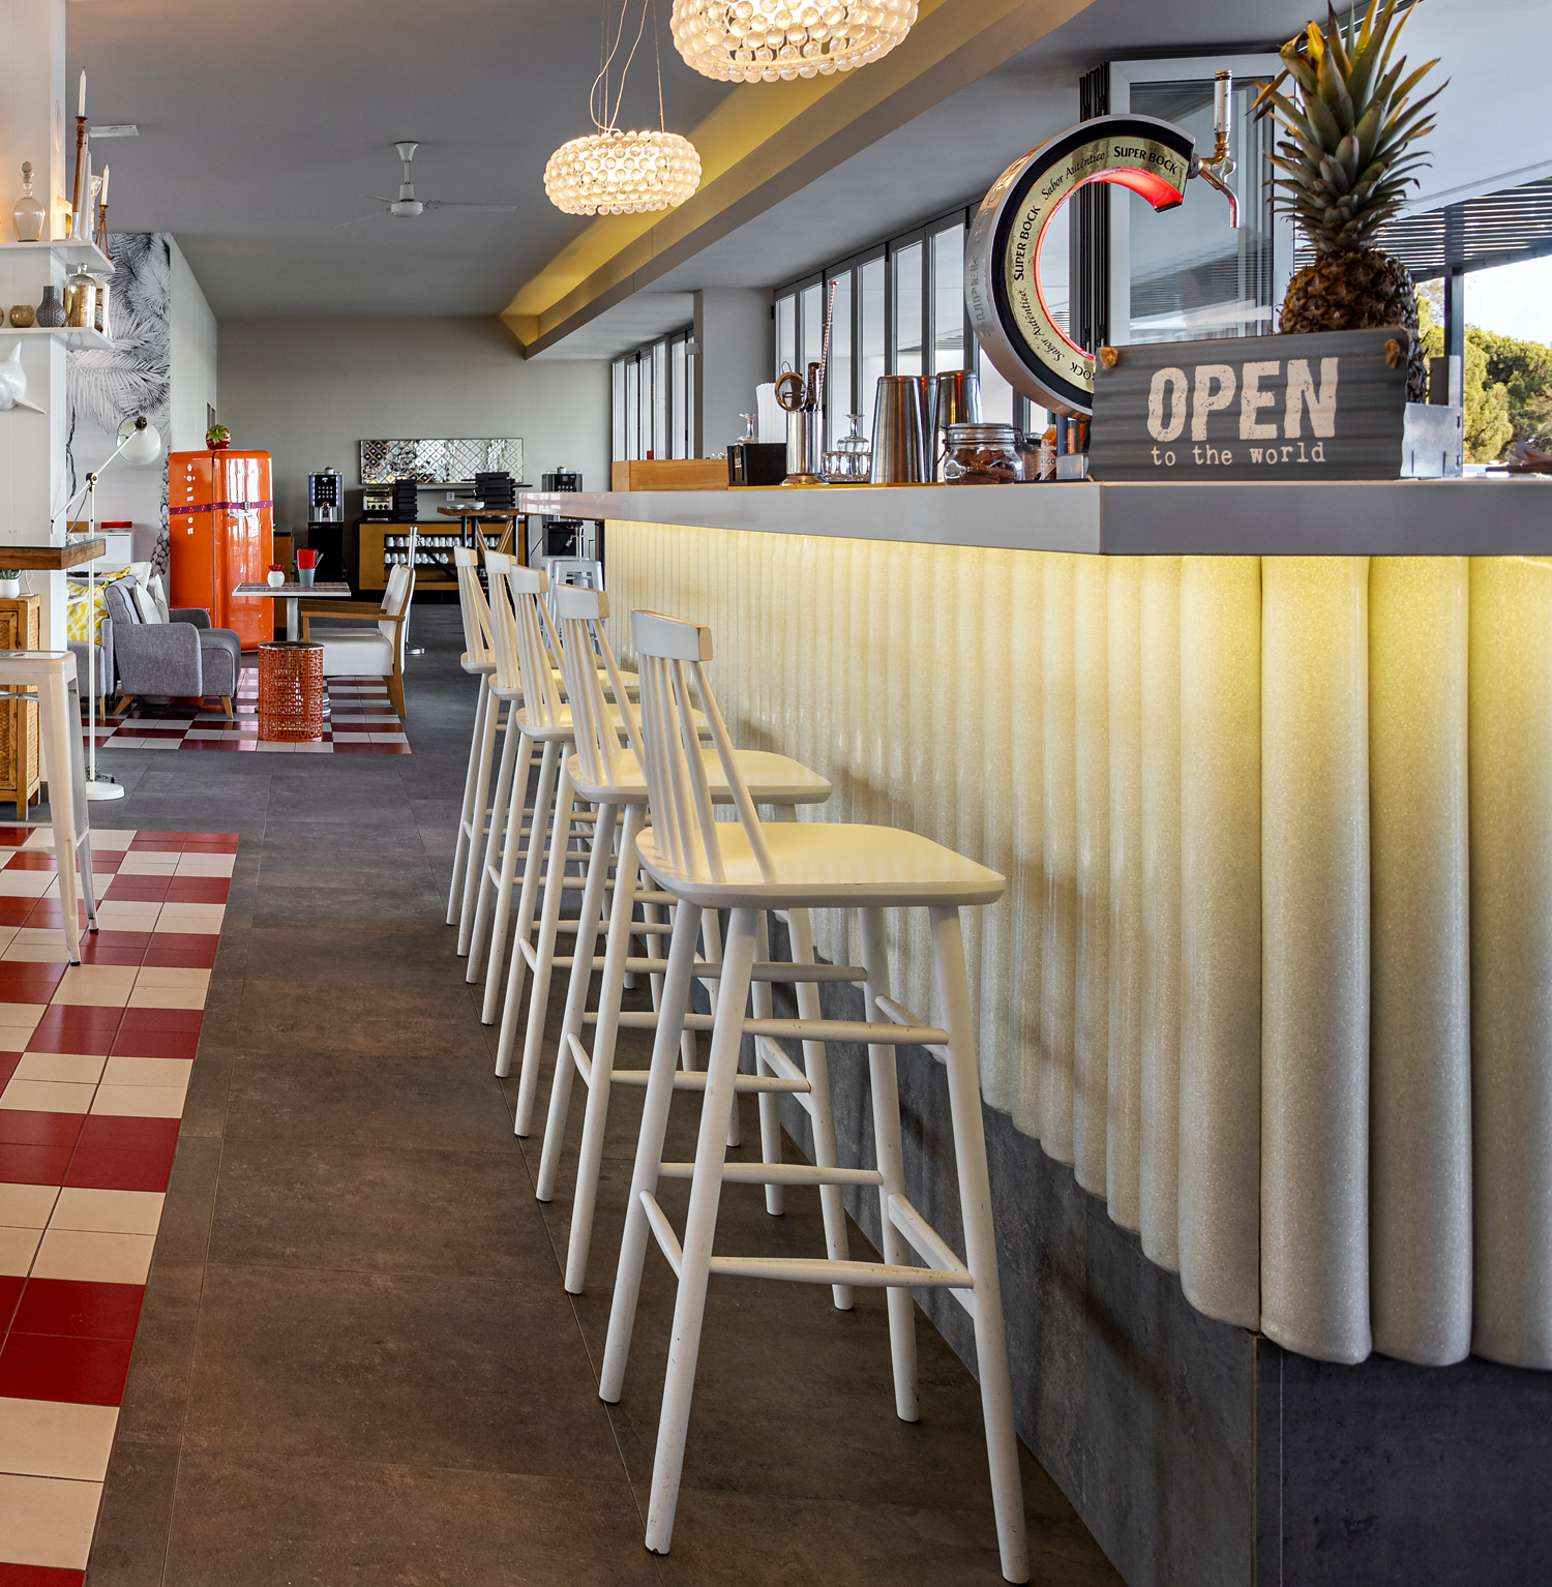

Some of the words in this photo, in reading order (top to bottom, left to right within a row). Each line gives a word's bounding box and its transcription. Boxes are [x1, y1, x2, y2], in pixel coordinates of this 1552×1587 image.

[1113, 145, 1147, 159] SUPER
[1149, 152, 1177, 175] BOCK
[1041, 172, 1063, 200] Sabor
[1013, 242, 1027, 281] SUPER
[1020, 205, 1041, 240] BOCK
[1041, 338, 1065, 361] Sabor
[1070, 361, 1095, 381] OCK
[1147, 356, 1339, 442] OPEN
[1151, 446, 1176, 466] to
[1192, 445, 1233, 465] the
[1249, 442, 1326, 465] world
